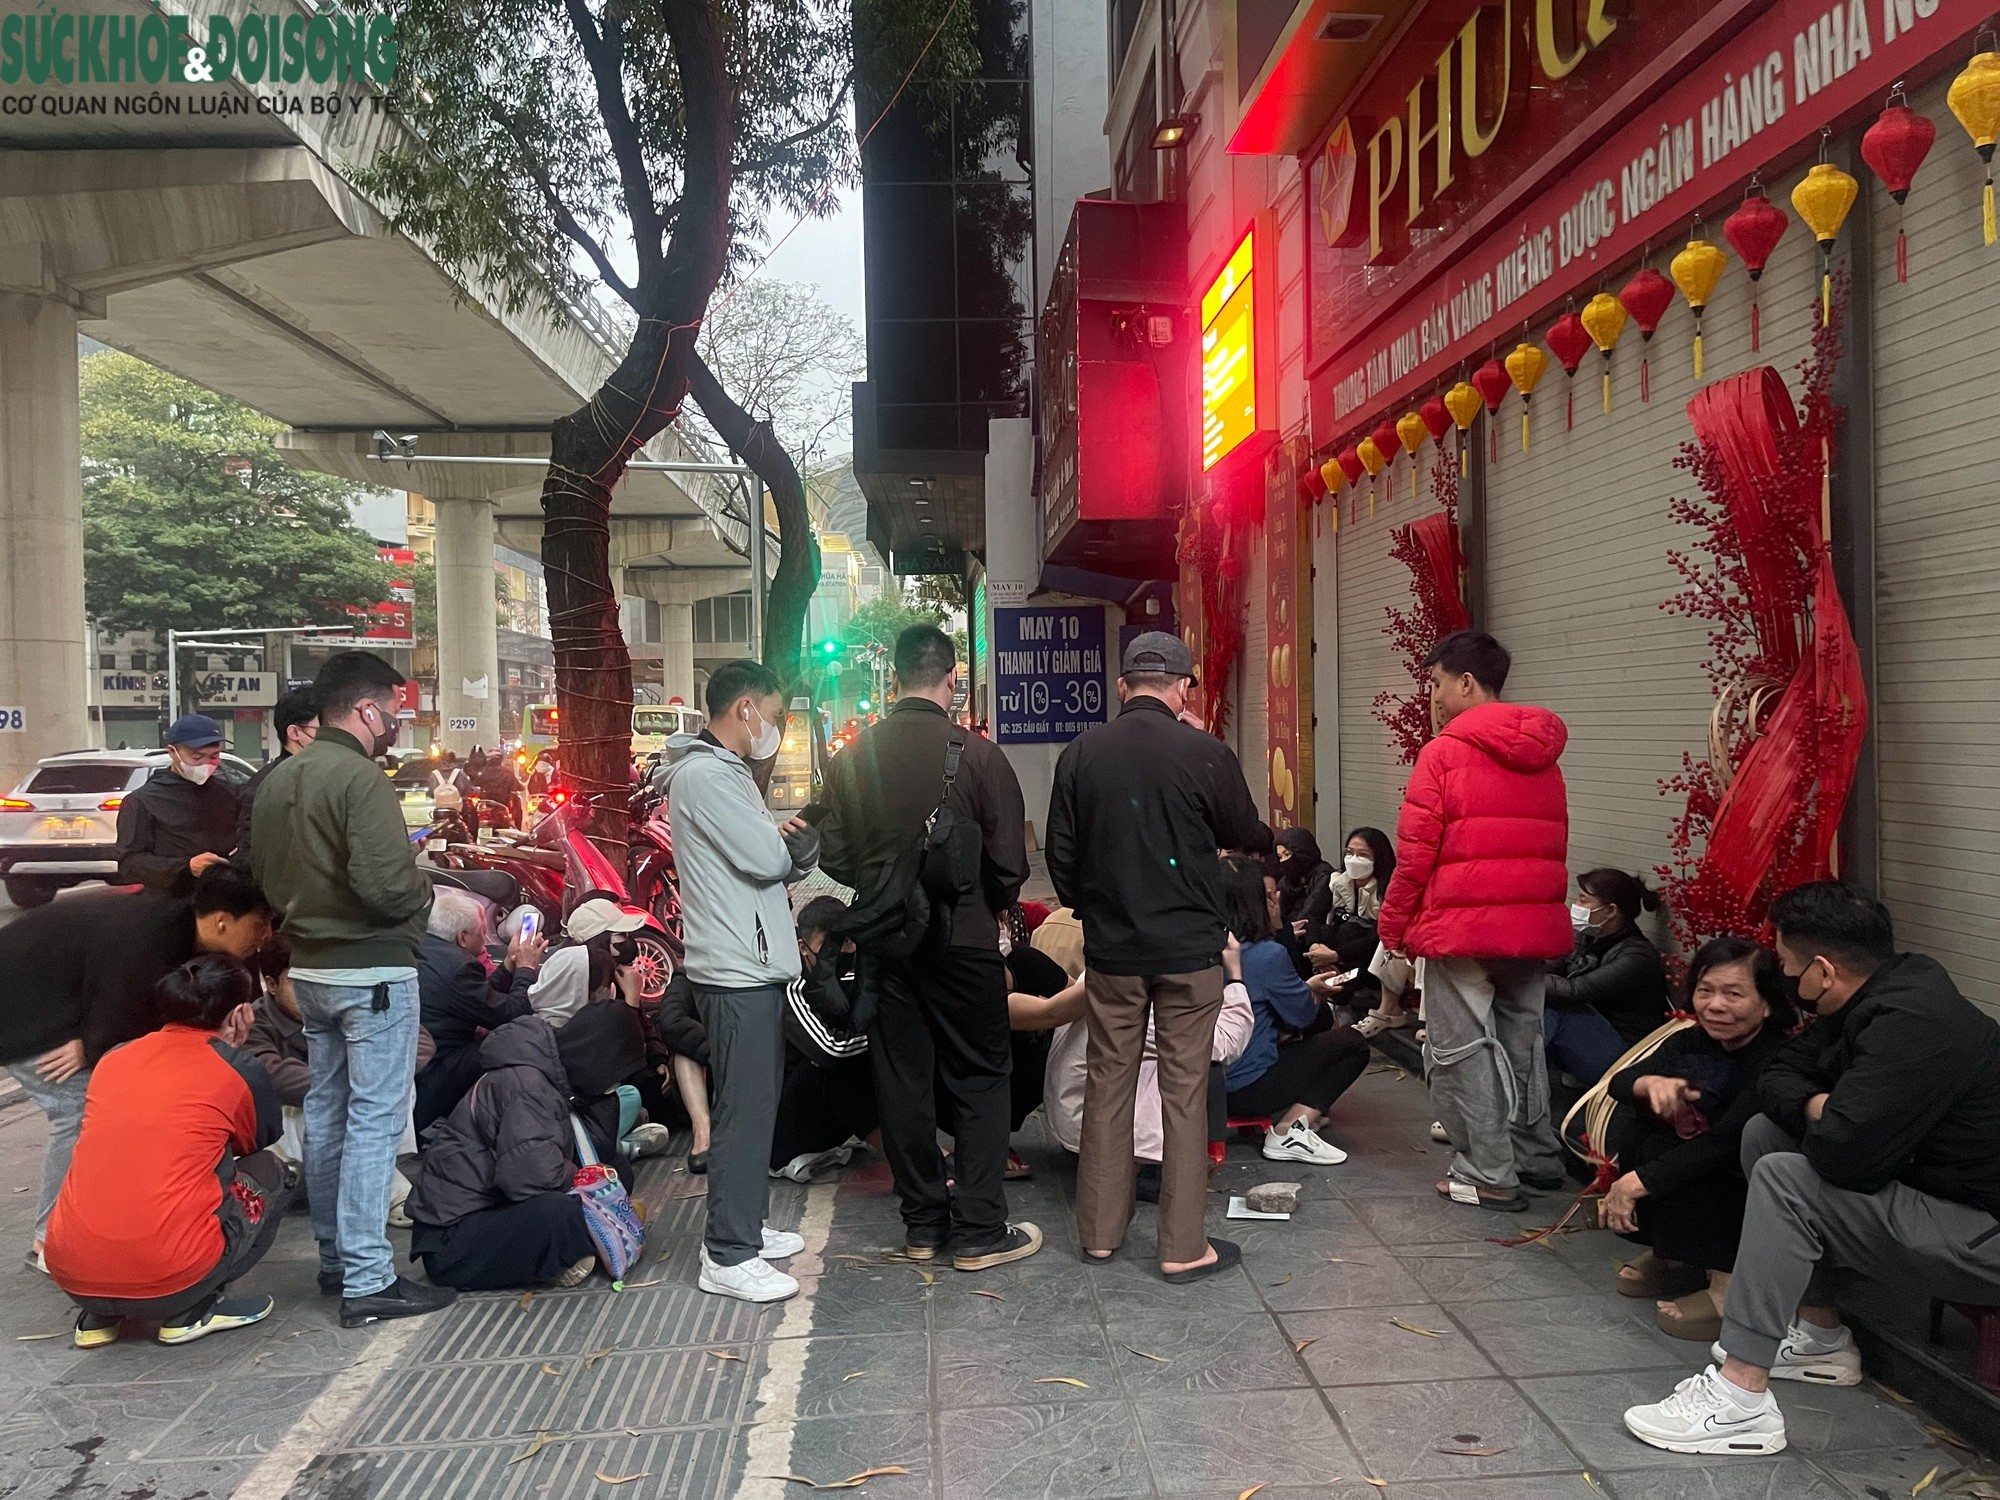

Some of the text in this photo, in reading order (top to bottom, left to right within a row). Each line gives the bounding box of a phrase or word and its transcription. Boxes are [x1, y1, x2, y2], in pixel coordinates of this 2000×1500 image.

[1391, 327, 1420, 384] MUA
[1421, 302, 1450, 362] BÁN
[1451, 279, 1492, 341] VÀNG
[1497, 224, 1554, 312] MIẾNG
[1559, 178, 1616, 268] ĐƯỢC
[1621, 122, 1695, 224] NGÂN
[1702, 50, 1786, 170] HÀNG
[992, 583, 1023, 591] MAY 10
[1019, 616, 1080, 640] MAY 10
[999, 642, 1102, 675] THANH LÝ GIẢM GIÁ
[237, 677, 261, 691] AN
[0, 709, 23, 730] 98
[450, 719, 476, 730] P299
[1011, 723, 1023, 734] 325
